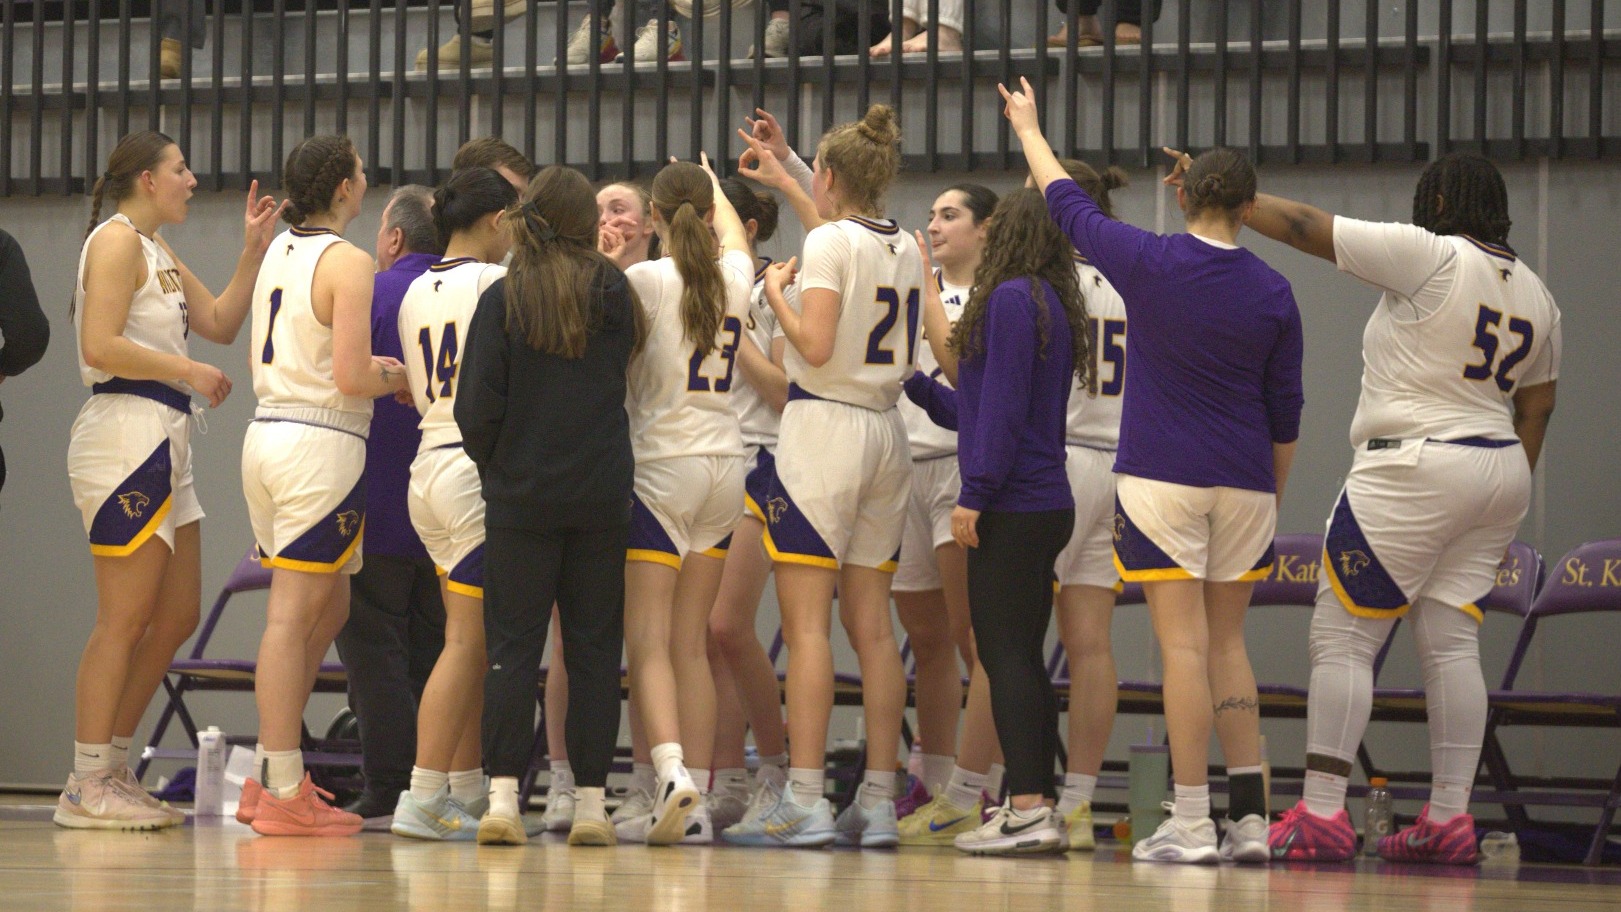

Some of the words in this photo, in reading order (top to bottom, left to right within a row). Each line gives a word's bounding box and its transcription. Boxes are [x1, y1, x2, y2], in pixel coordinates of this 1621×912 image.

[261, 285, 284, 367] 1
[417, 319, 460, 405] 14
[686, 314, 742, 394] 23
[864, 284, 920, 366] 21
[1087, 316, 1127, 397] 15
[1462, 303, 1535, 394] 52
[1494, 558, 1522, 587] e's
[1561, 556, 1593, 588] St.
[1599, 558, 1621, 588] K
